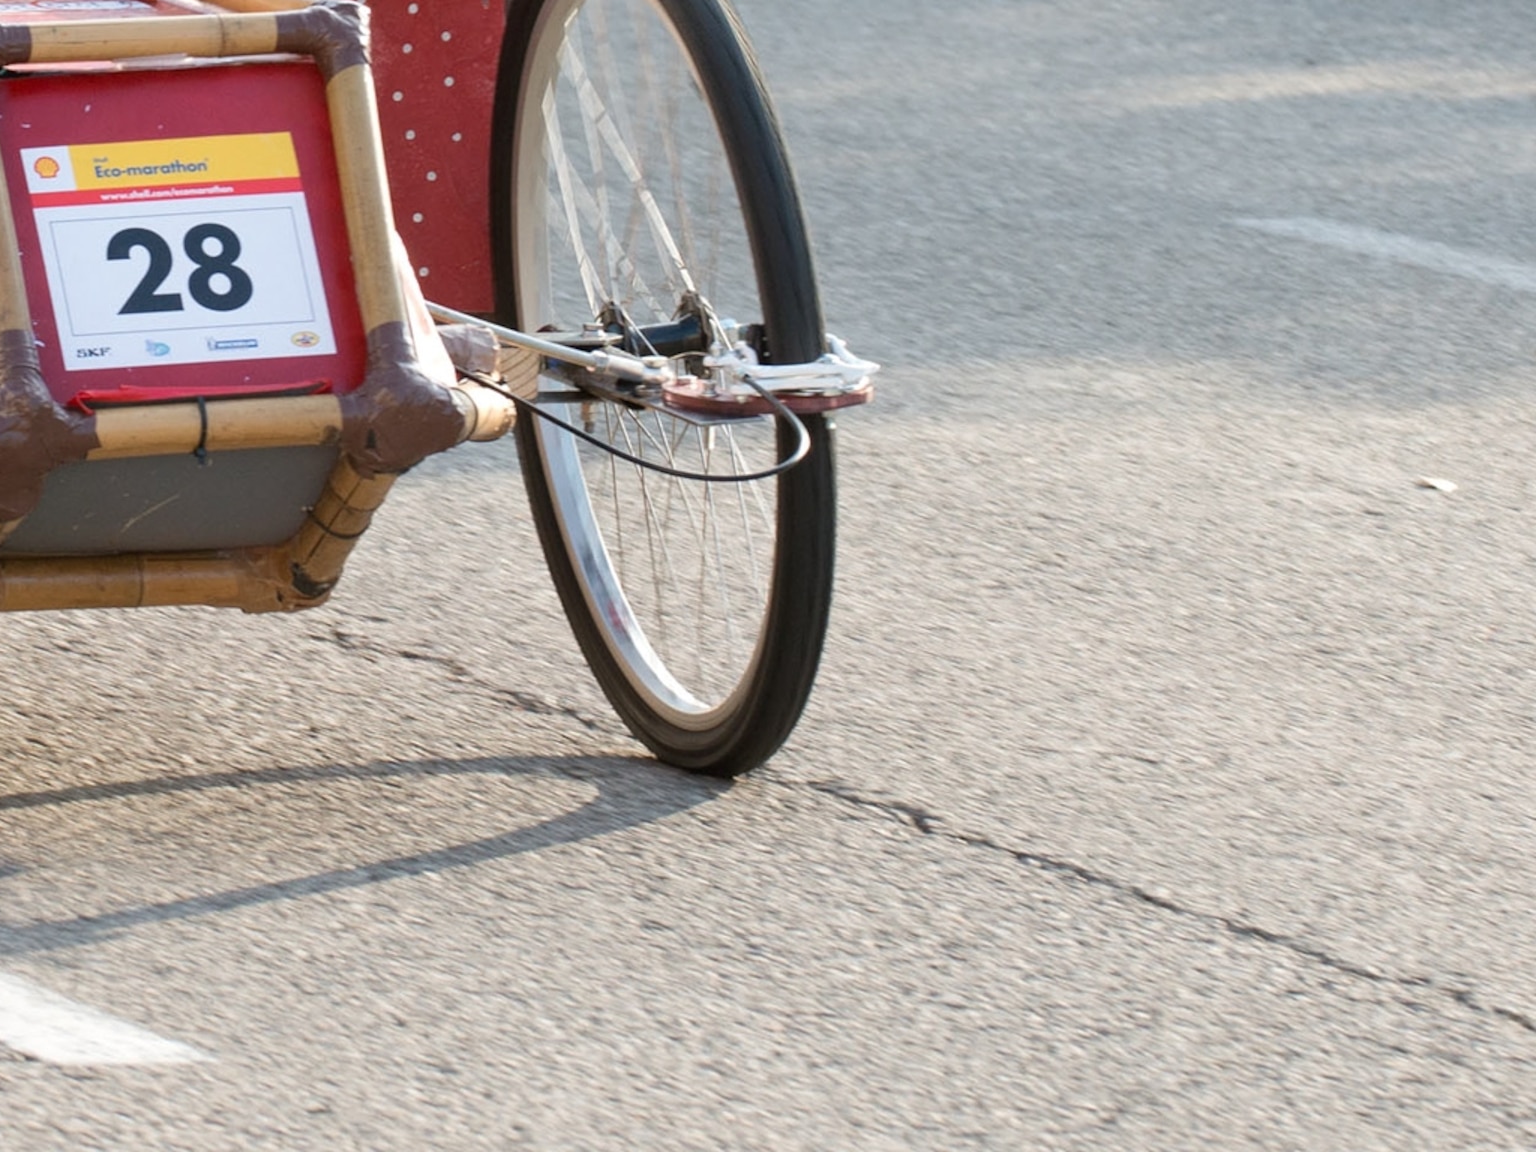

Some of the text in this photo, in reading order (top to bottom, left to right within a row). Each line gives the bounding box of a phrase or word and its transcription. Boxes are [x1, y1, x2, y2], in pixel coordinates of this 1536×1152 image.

[93, 159, 208, 179] Eco-marathon
[105, 222, 254, 316] 28
[76, 346, 112, 359] SKF
